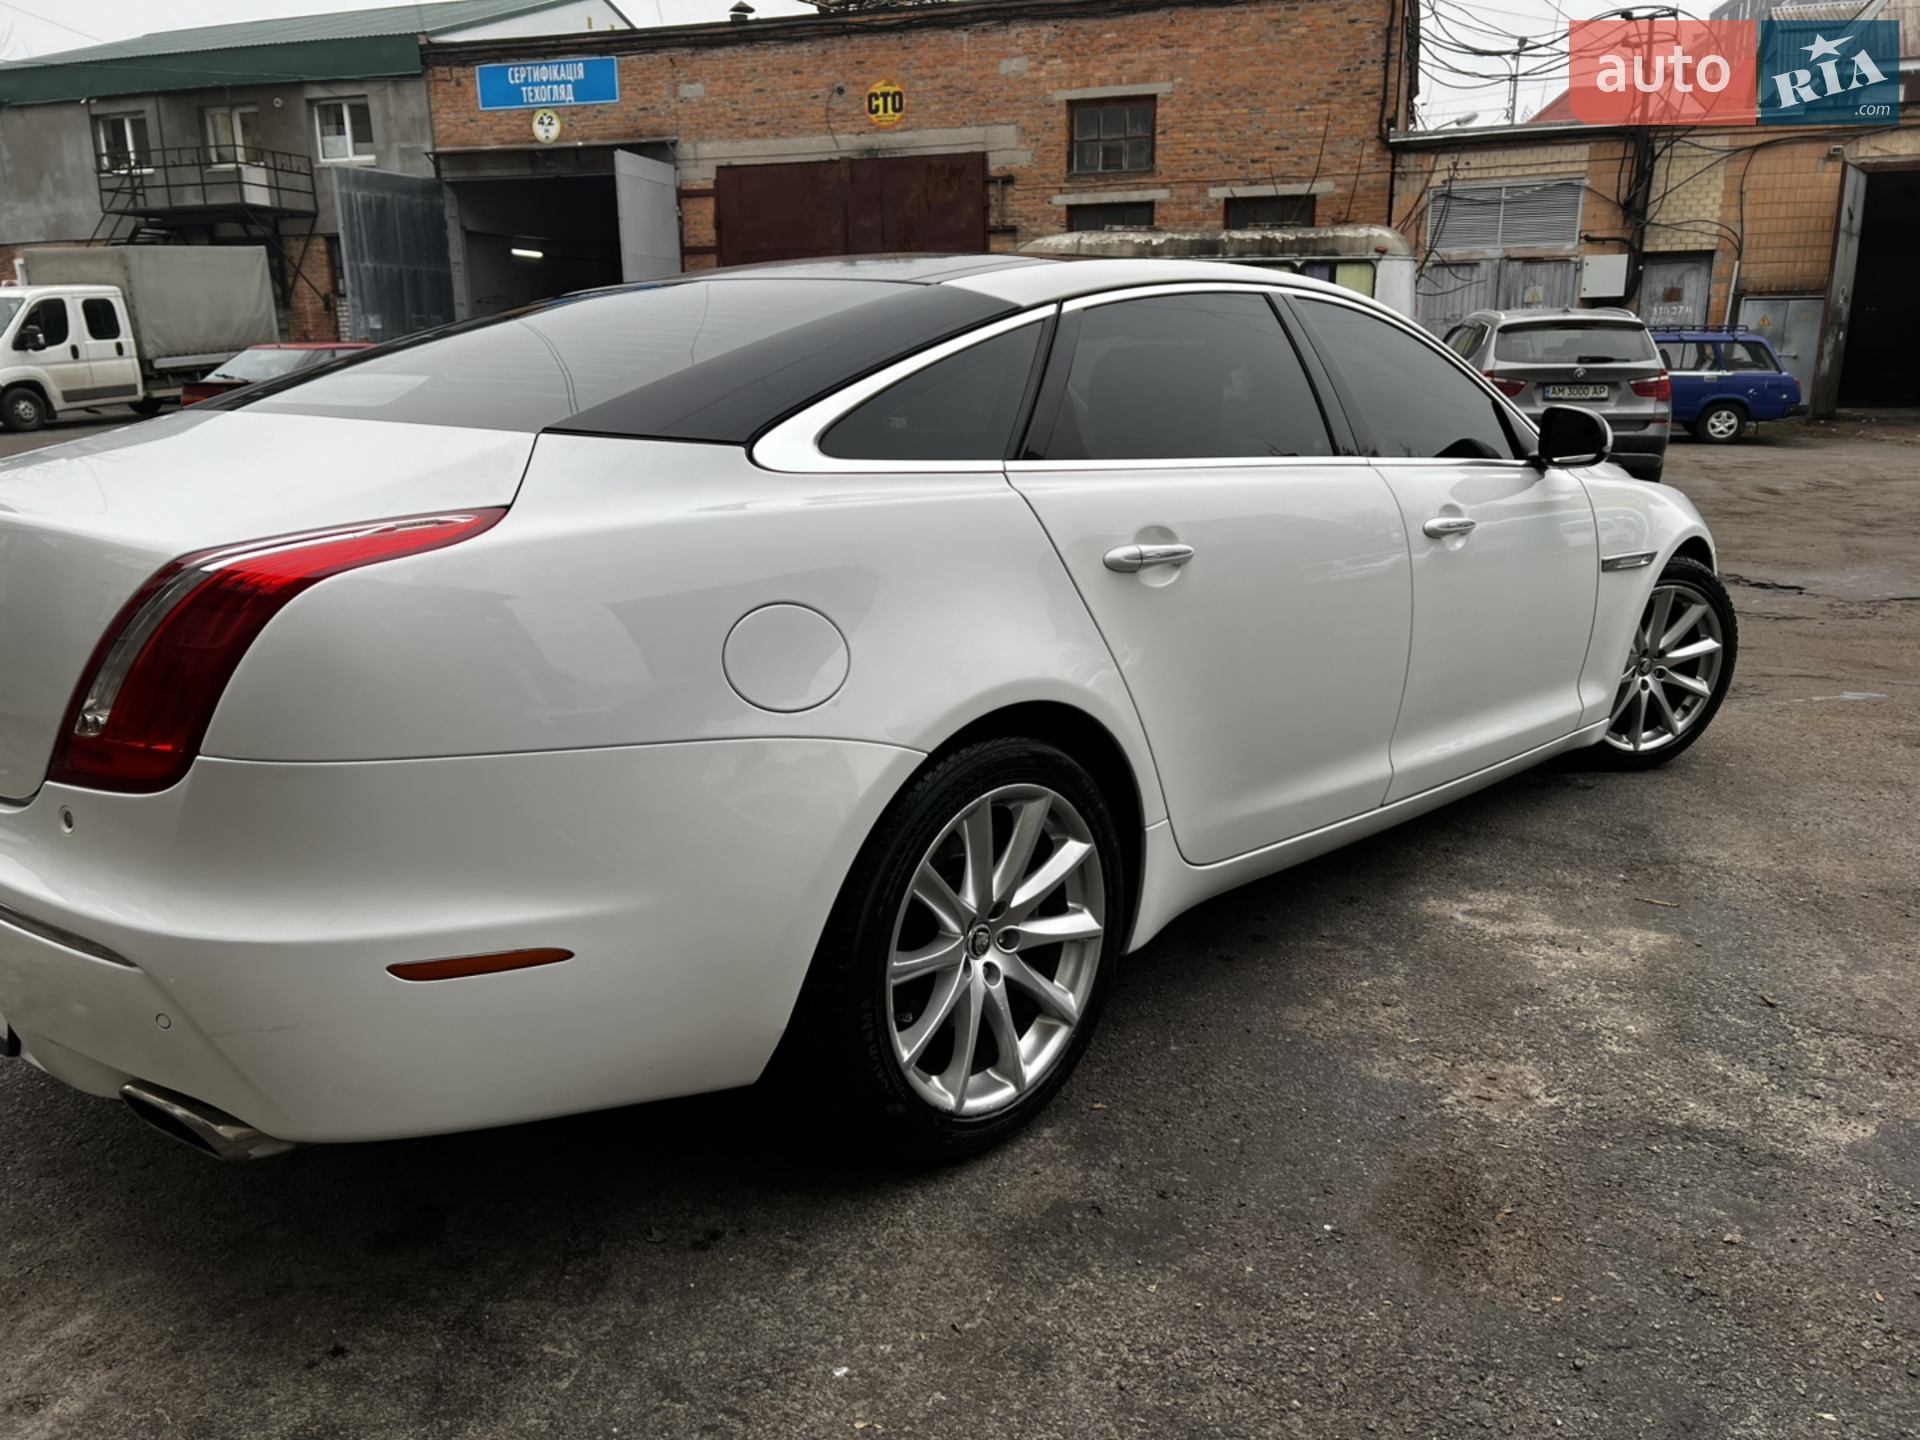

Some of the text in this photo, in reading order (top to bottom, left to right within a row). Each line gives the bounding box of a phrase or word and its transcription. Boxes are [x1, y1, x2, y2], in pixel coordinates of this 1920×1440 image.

[508, 63, 584, 84] СЕРТИФІКАЦІЯ
[521, 84, 574, 103] ТЕХОГЛЯД
[867, 91, 904, 115] СТО
[1551, 386, 1606, 396] AM 3000 AP
